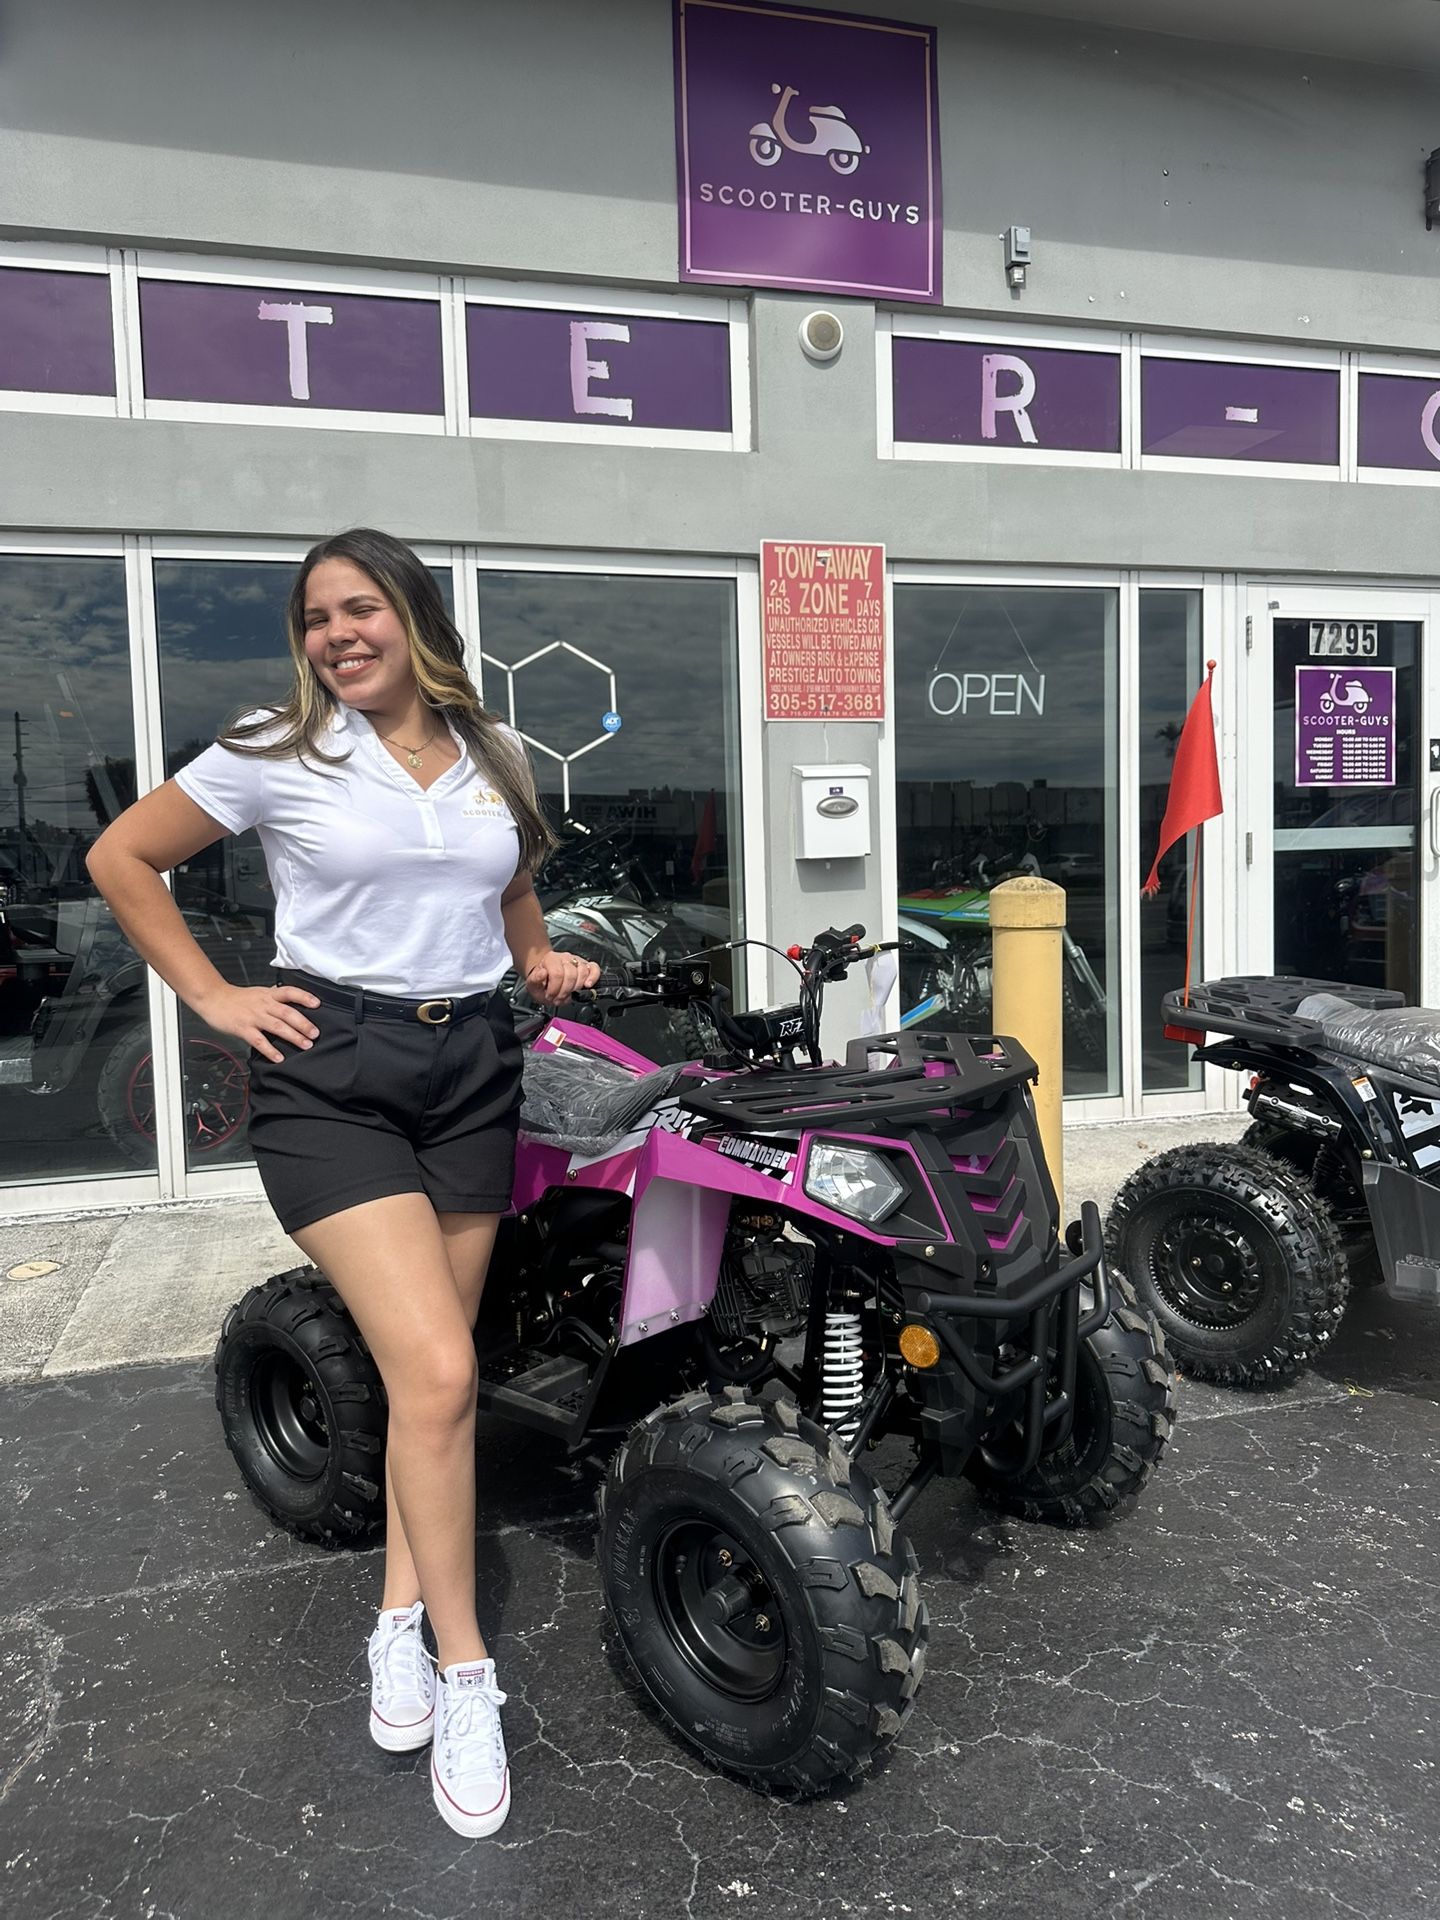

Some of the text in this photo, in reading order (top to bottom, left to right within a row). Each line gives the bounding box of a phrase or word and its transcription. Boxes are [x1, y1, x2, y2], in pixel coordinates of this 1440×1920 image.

[699, 182, 920, 225] SCOOTER-GUYS
[258, 299, 333, 400] T
[569, 320, 633, 420] E
[981, 353, 1038, 444] R
[774, 545, 873, 580] TOW-AWAY
[766, 597, 881, 617] HRS DAYS
[769, 579, 873, 615] 24 ZONE 7
[768, 616, 880, 634] UNAUTHORIZED VEHICLES OR
[766, 633, 883, 650] VESSELS WILL BE TOWED AWAY
[1312, 622, 1376, 655] 7295
[770, 650, 781, 666] AT
[782, 650, 817, 667] OWNERS
[817, 651, 836, 667] RISK
[844, 651, 879, 667] EXPENSE
[768, 667, 881, 684] PRESTIGE AUTO TOWING
[770, 693, 881, 711] 305-517-3681
[928, 672, 1046, 716] OPEN
[1303, 715, 1389, 726] SCOOTER-GUYS
[717, 1135, 792, 1170] COMMANDER
